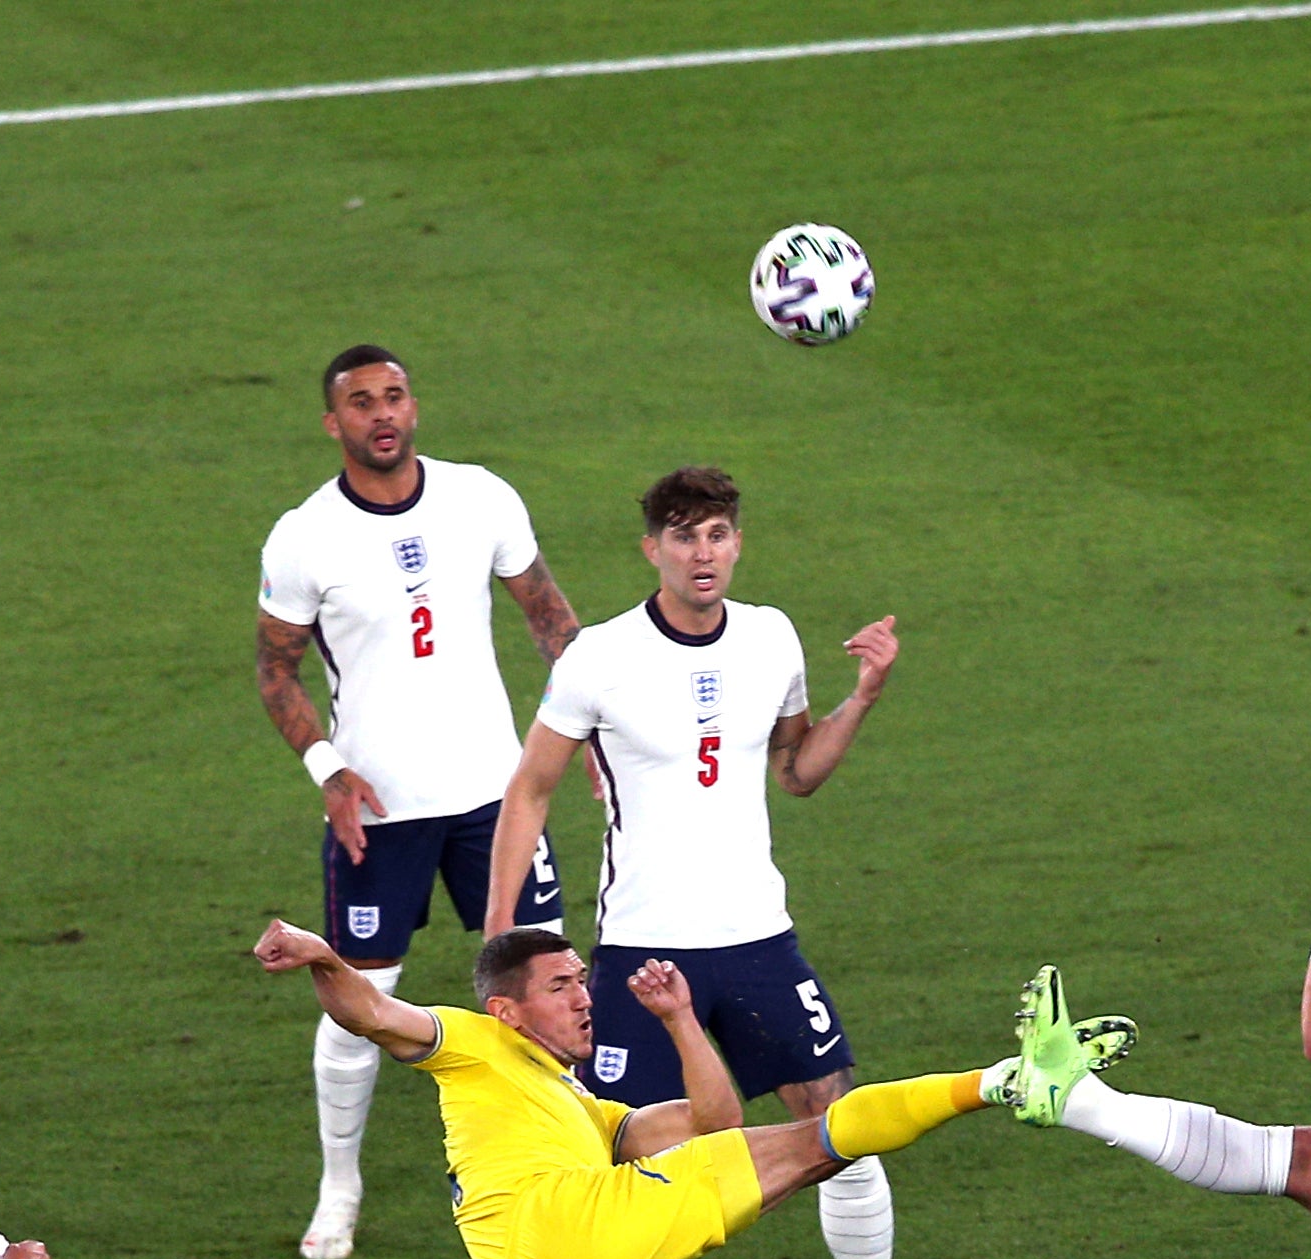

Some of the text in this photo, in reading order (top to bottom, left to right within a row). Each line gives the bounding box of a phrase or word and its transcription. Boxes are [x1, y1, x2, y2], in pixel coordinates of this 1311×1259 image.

[410, 606, 434, 658] 2
[697, 736, 720, 787] 5
[533, 834, 555, 883] 2
[795, 979, 831, 1034] 5
